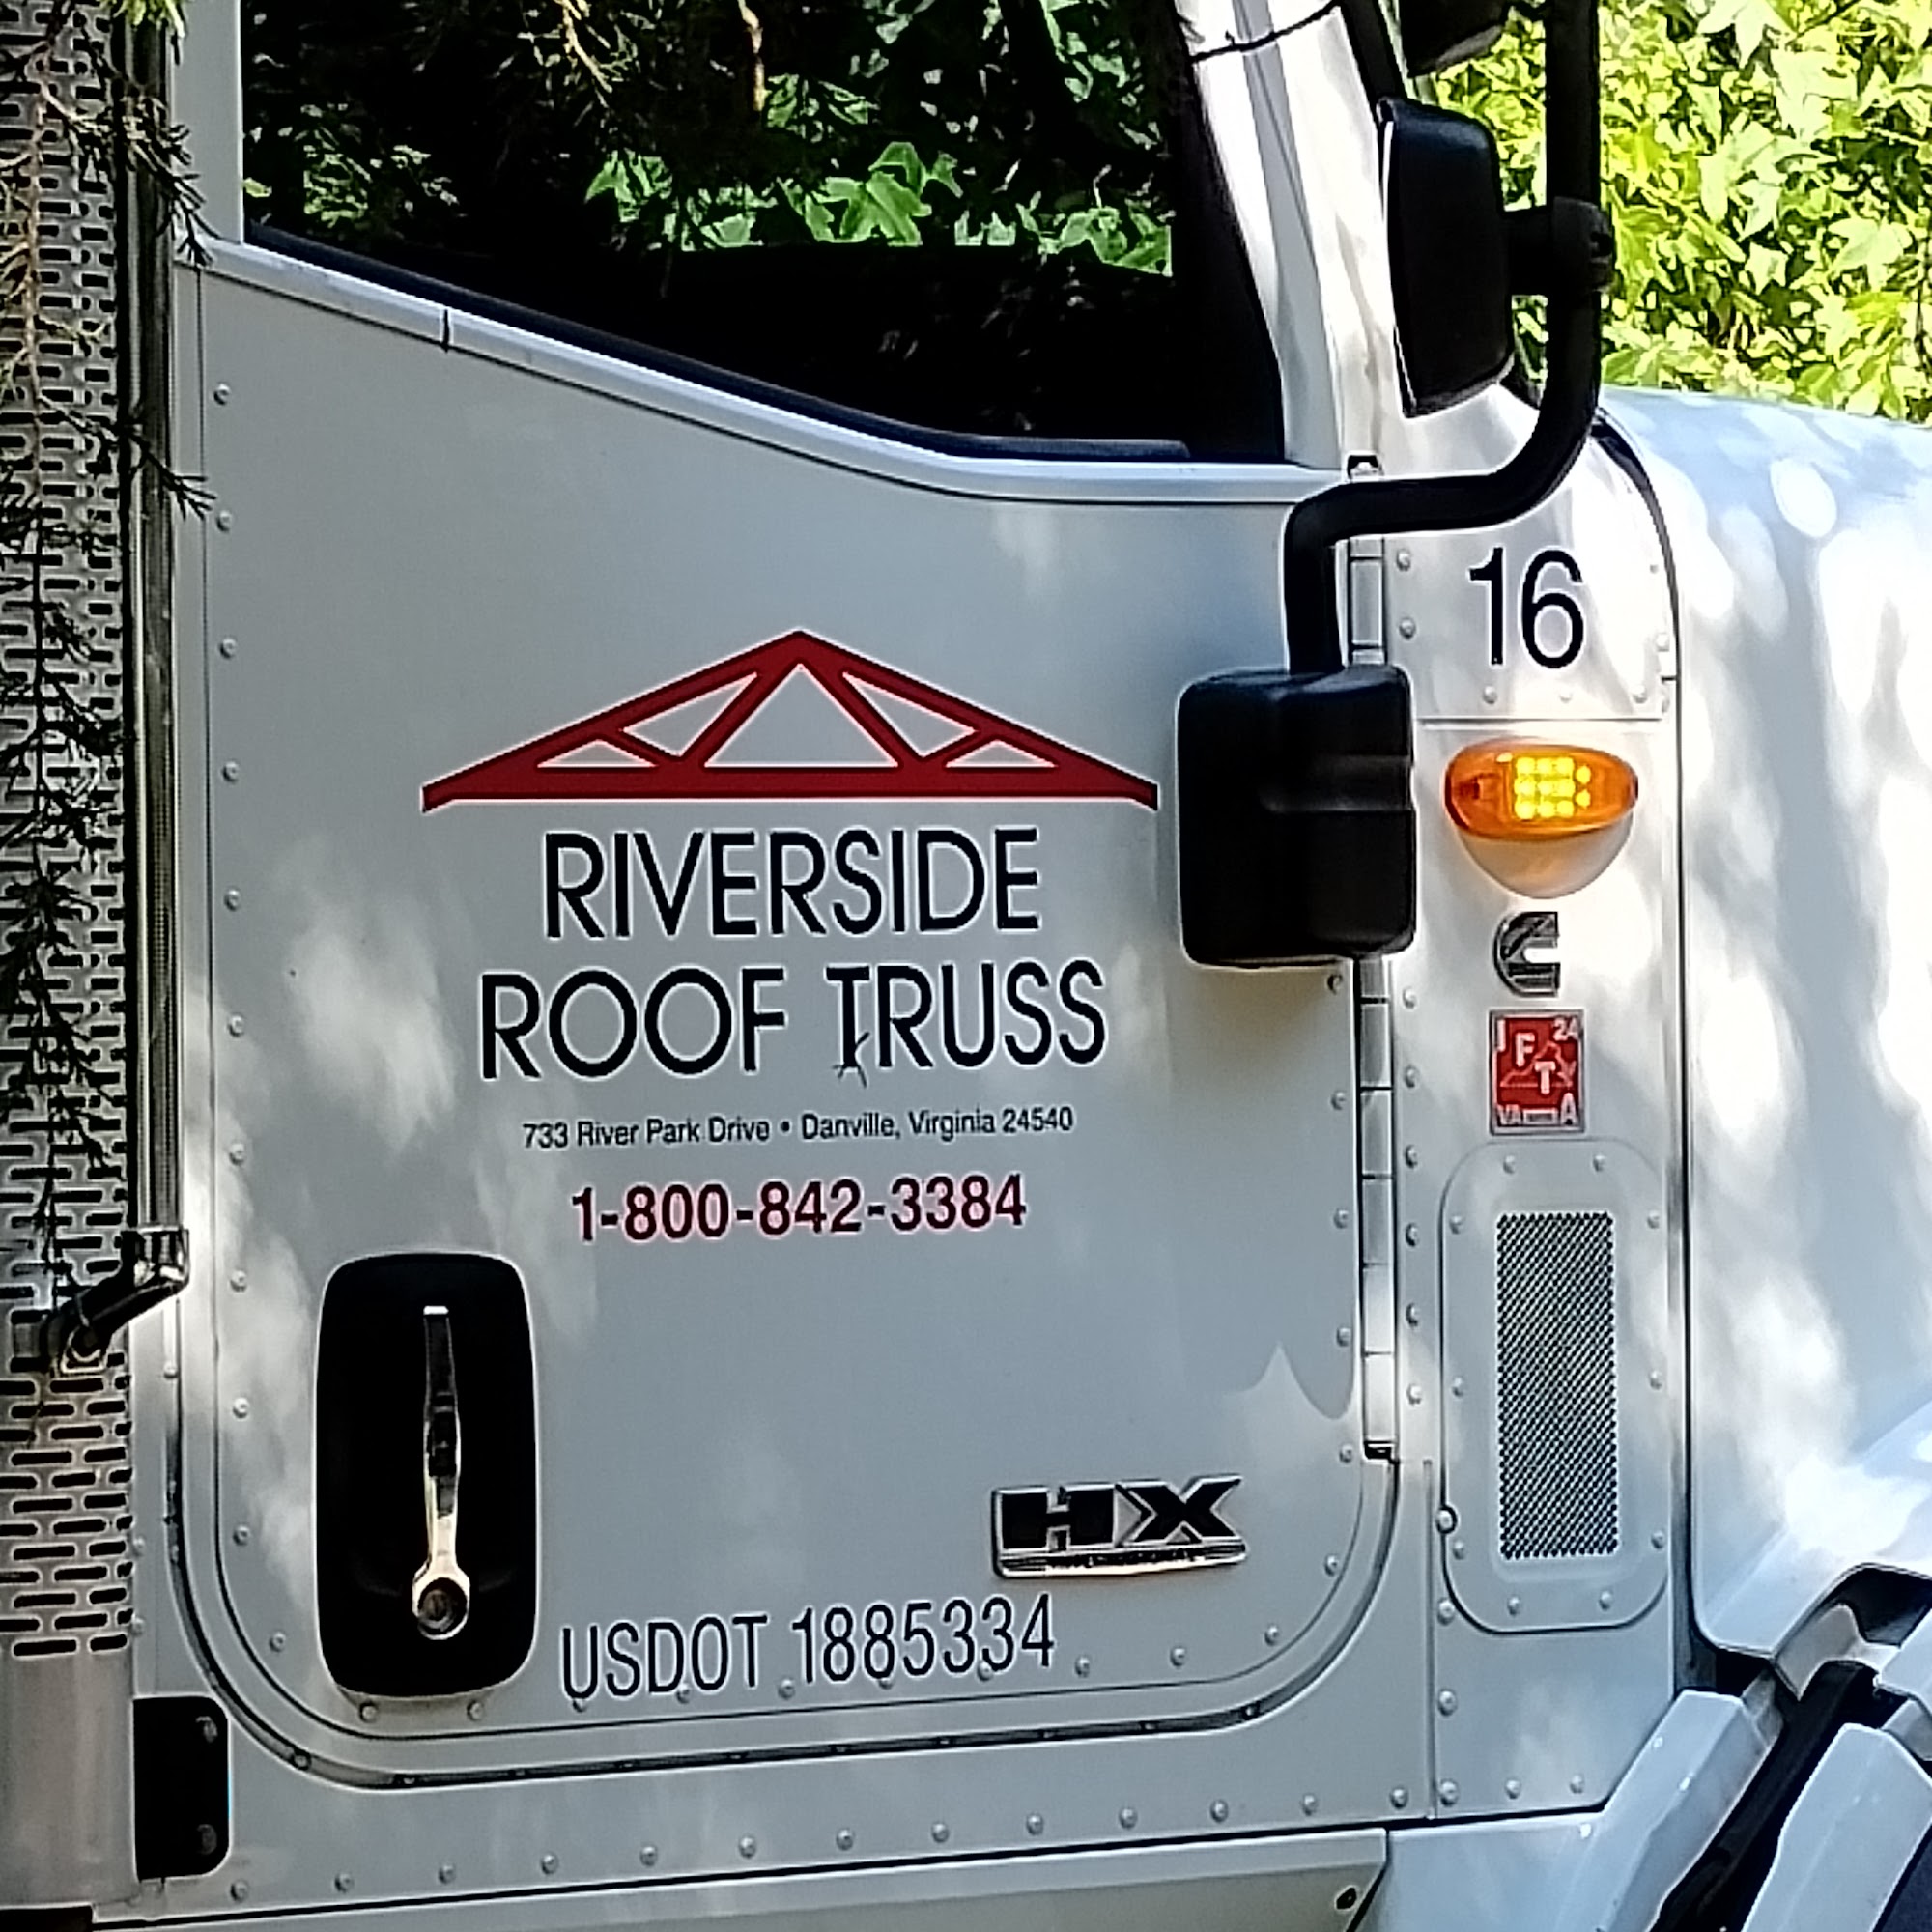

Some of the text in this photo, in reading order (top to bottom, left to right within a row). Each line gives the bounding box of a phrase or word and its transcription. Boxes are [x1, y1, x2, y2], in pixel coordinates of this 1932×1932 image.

[1468, 547, 1584, 668] 16
[544, 827, 1039, 938] RIVERSIDE
[481, 959, 1105, 1079] ROOF TRUSS
[523, 1106, 1073, 1149] 733 River Park Drive Danville, Virginia 24540
[572, 1173, 1027, 1242] 1-800-842-3384
[993, 1474, 1244, 1551] HX
[559, 1592, 1056, 1699] USDOT 1885334
